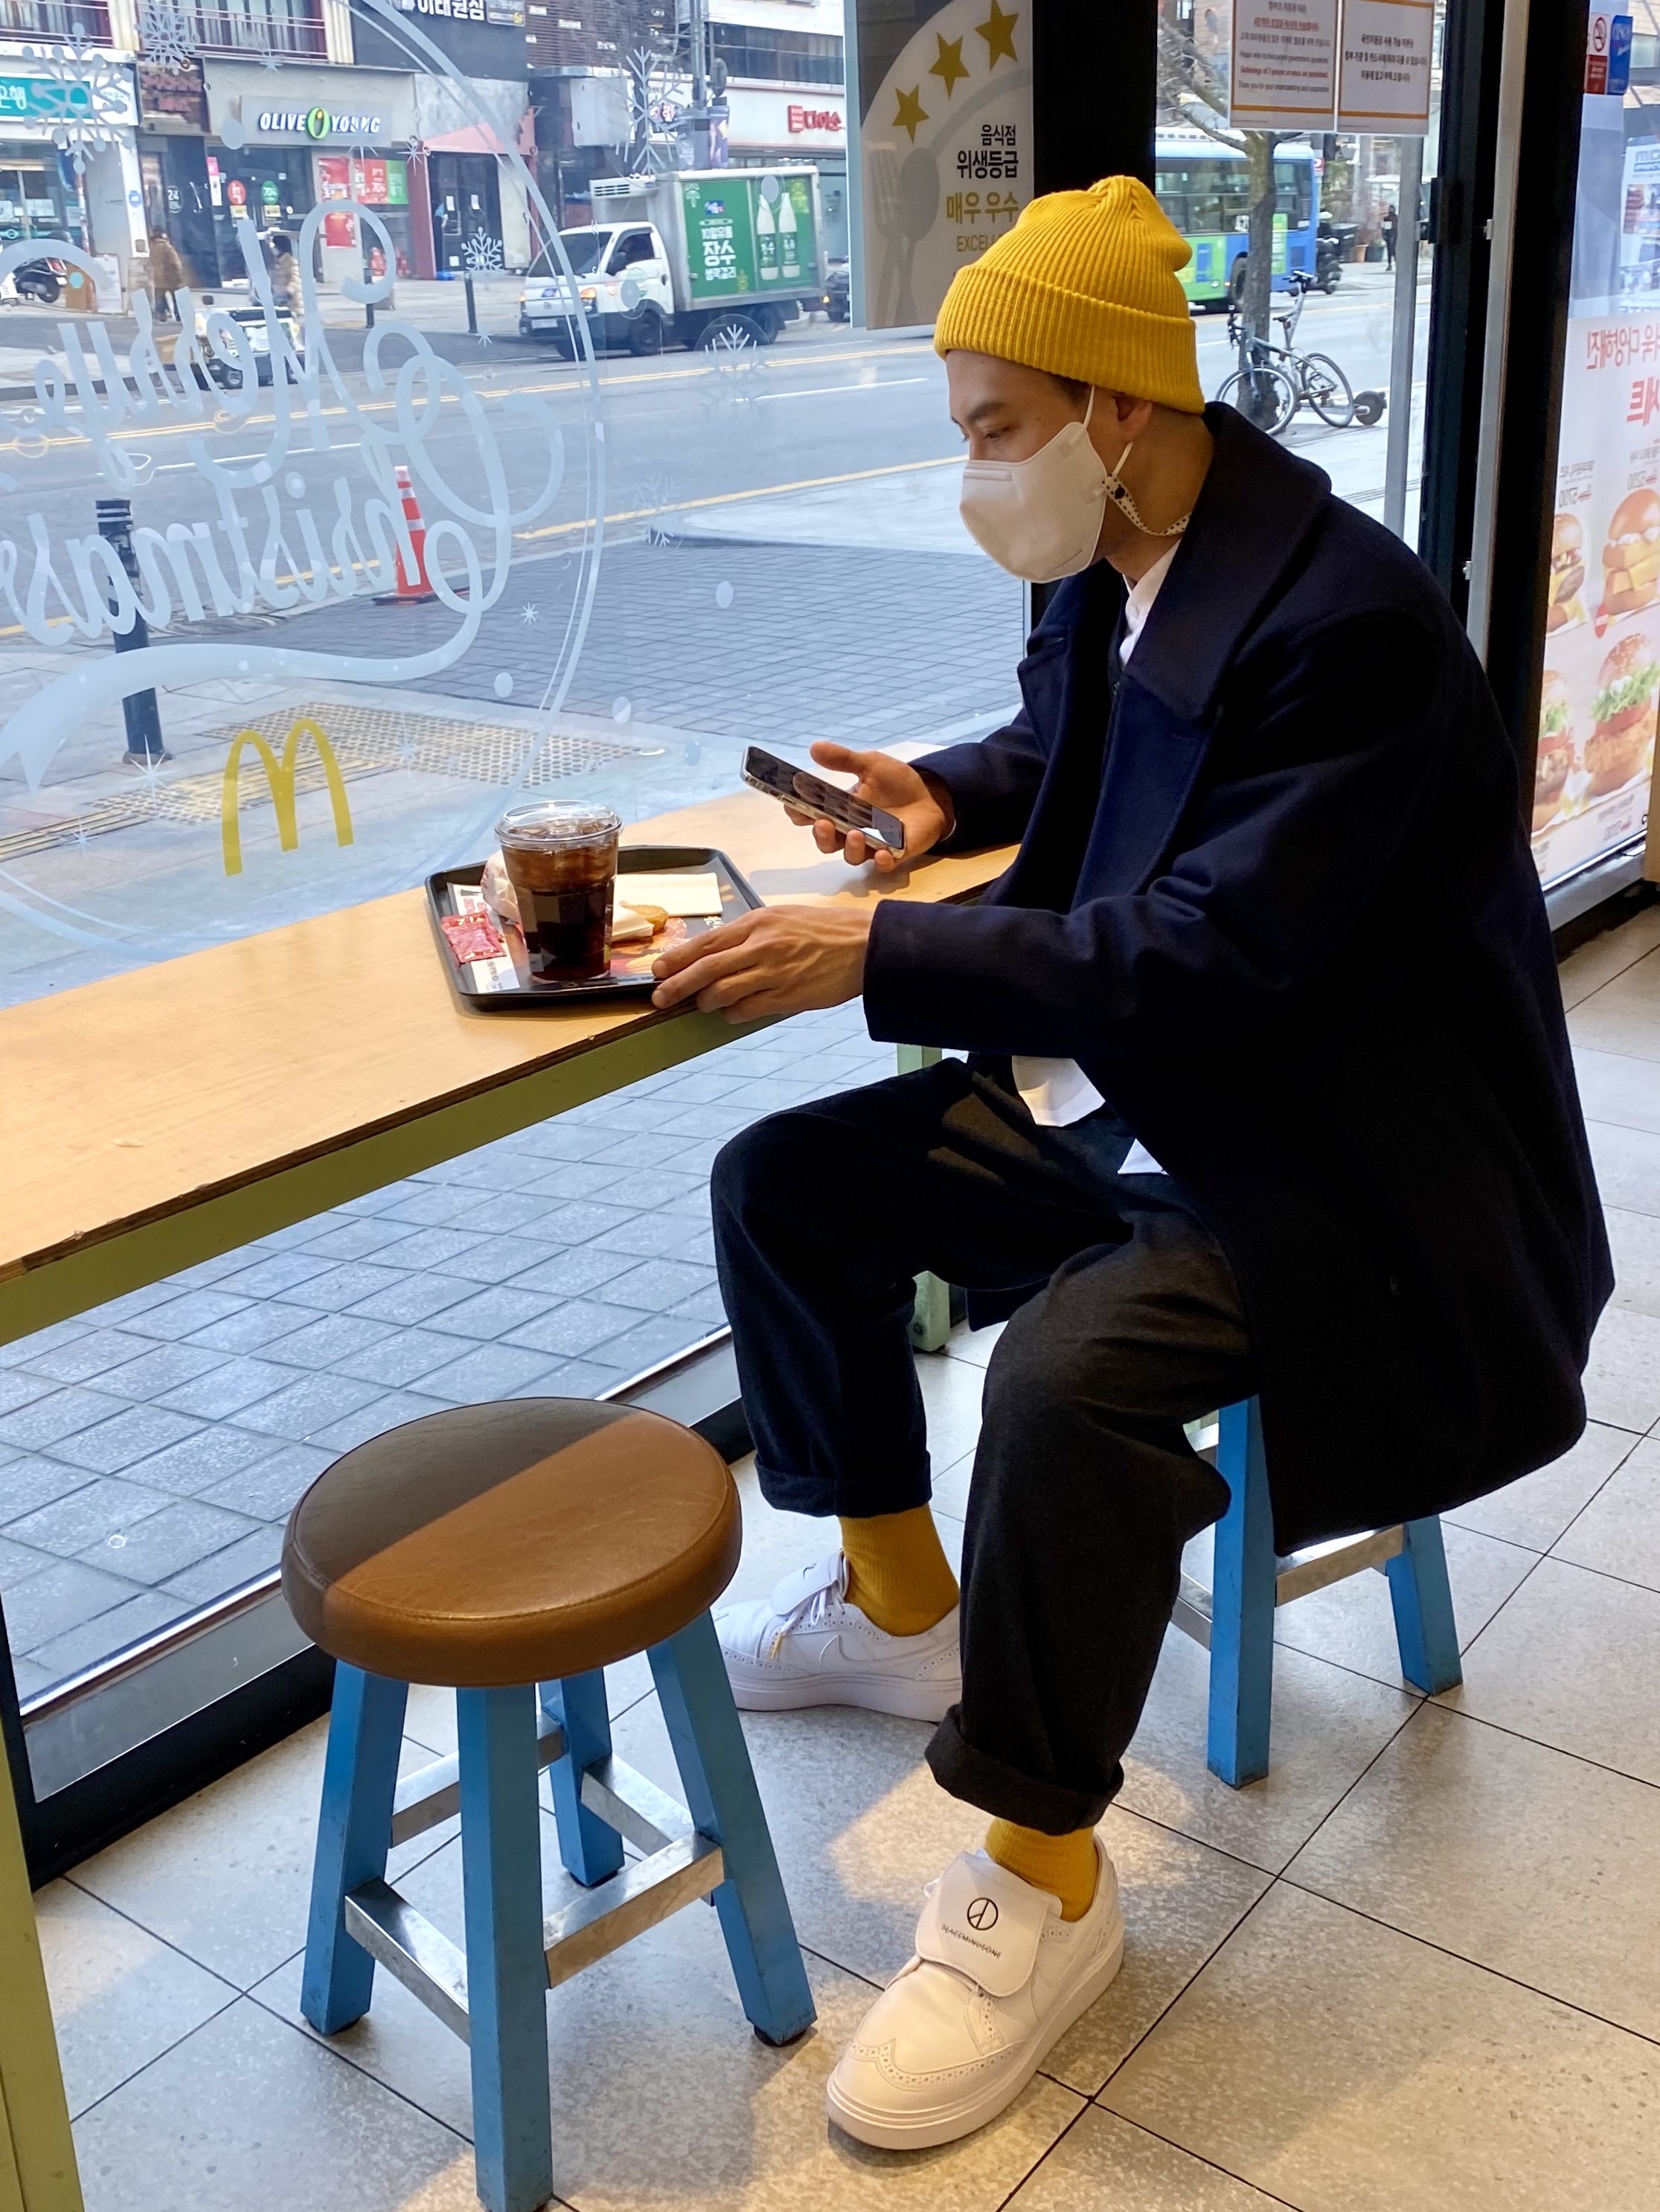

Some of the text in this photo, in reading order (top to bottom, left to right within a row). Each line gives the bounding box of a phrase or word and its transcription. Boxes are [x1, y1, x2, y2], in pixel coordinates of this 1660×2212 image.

[260, 112, 380, 133] OLIVE YOUNG
[981, 124, 1016, 147] 음식점
[957, 150, 1019, 179] 위생등급
[946, 190, 1019, 225] 매우 우수
[702, 240, 736, 266] 장수
[956, 234, 1004, 251] EXCEL
[941, 1923, 1002, 1960] PEACEMINUSONE
